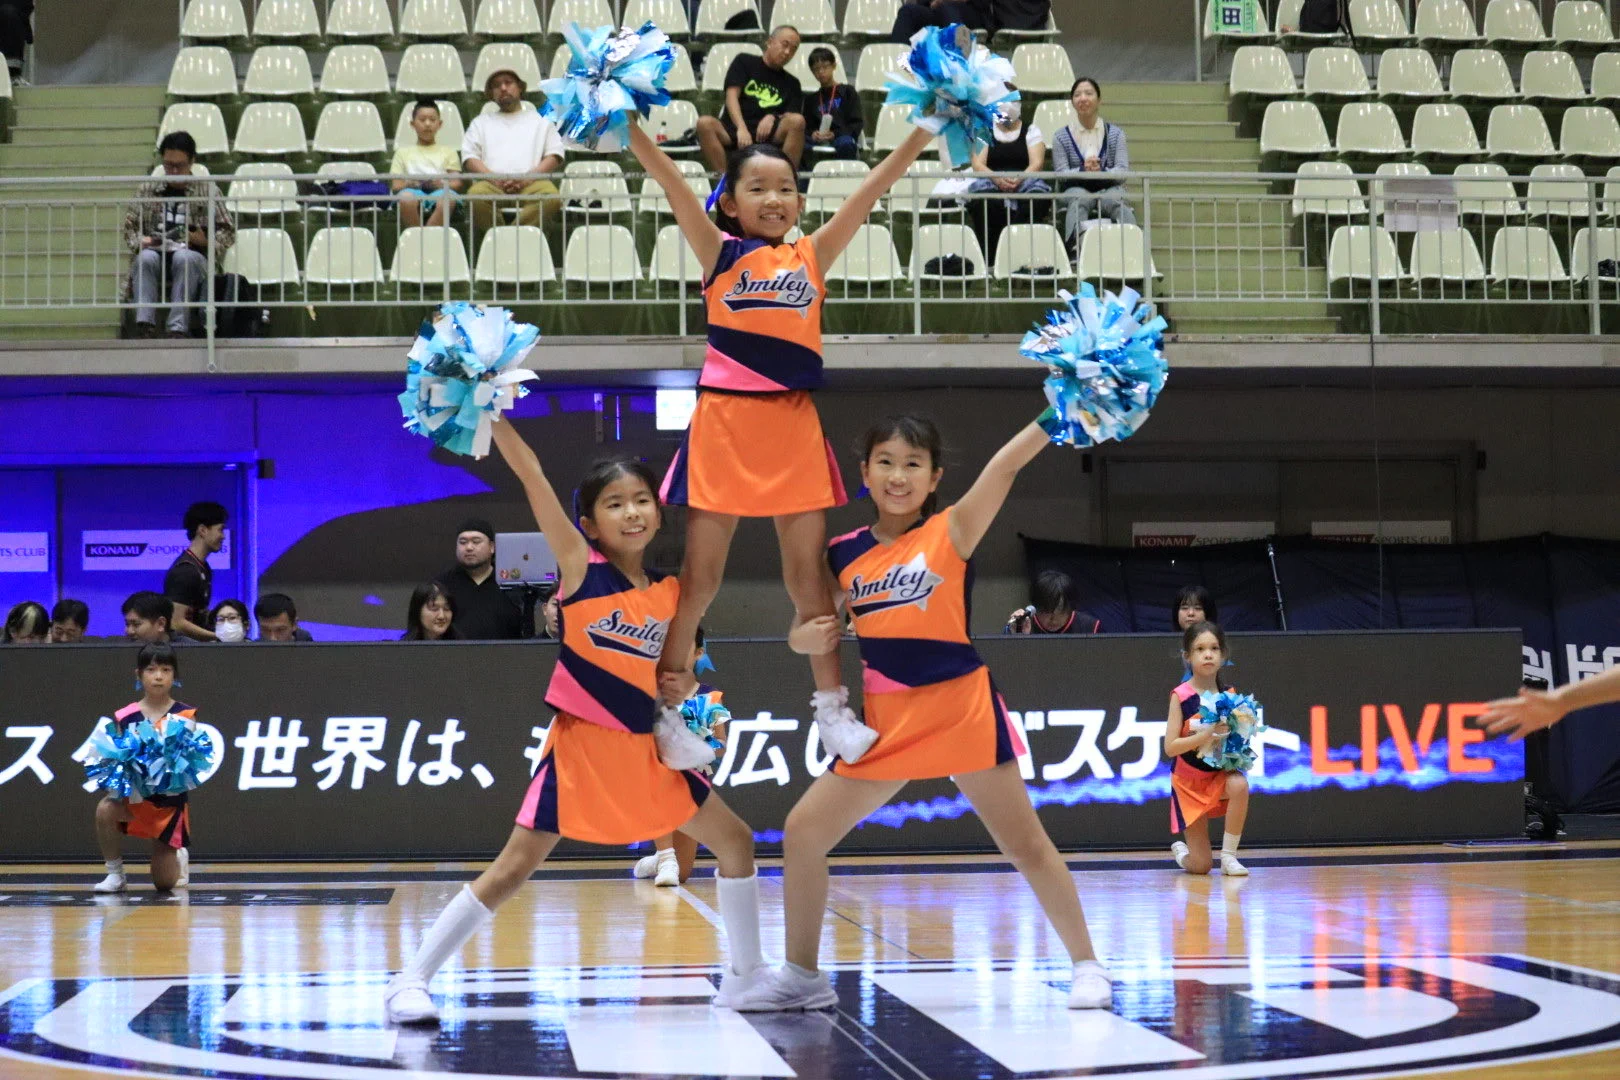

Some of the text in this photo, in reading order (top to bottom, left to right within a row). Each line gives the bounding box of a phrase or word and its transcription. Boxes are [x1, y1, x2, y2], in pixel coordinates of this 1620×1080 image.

[725, 270, 809, 303] Smiley
[15, 547, 46, 557] CLUB
[89, 544, 188, 556] KONAMI SPORT
[1139, 536, 1188, 547] KONAMI
[848, 566, 927, 602] Smiley
[1310, 703, 1495, 775] LIVE
